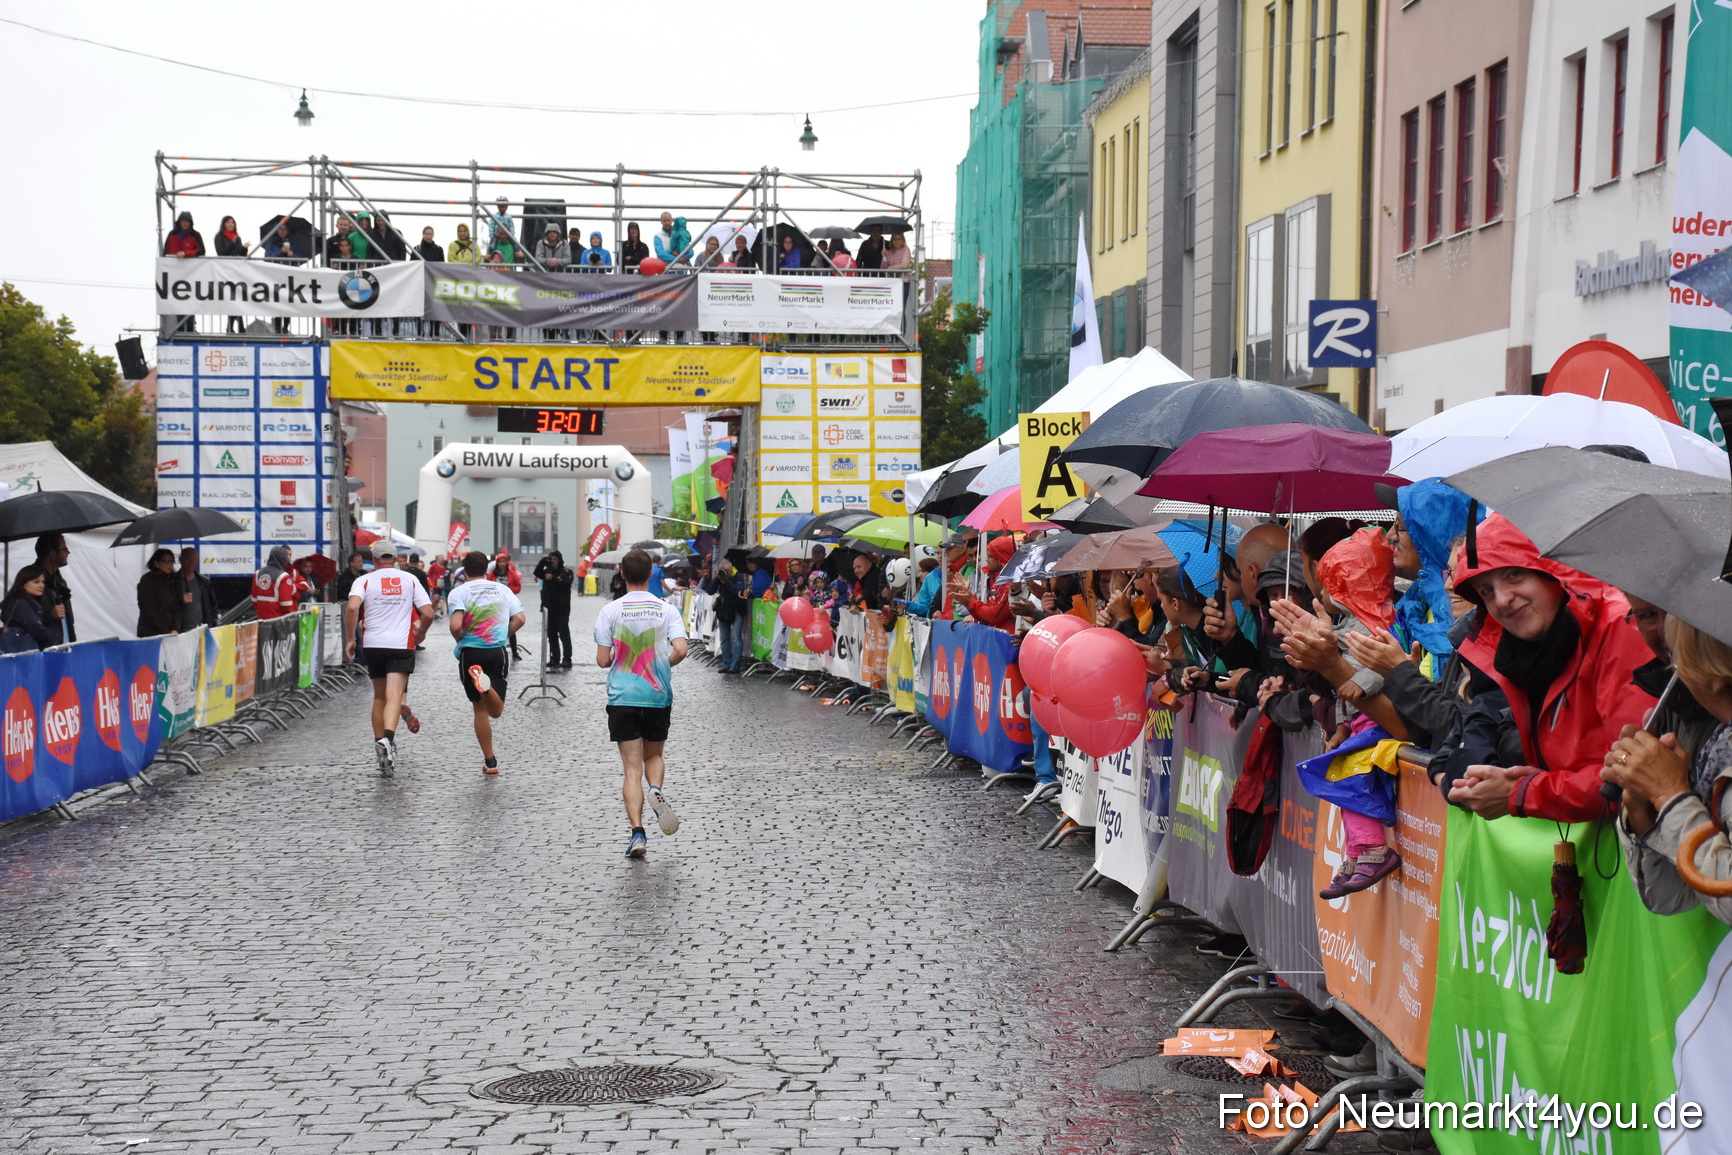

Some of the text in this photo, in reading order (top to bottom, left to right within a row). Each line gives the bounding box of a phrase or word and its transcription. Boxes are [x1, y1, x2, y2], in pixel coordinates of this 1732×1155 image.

[436, 281, 517, 302] BOCK
[536, 290, 575, 300] OFFICE
[707, 294, 755, 302] NeuerMarkt
[778, 295, 825, 304] NeuerMarkt
[847, 297, 894, 305] NeuerMarkt
[558, 304, 663, 314] www.bockonline.de
[355, 372, 448, 382] Neumarkter Stadtlauf
[474, 356, 620, 391] START
[646, 376, 736, 385] Neumarkter Stadtlauf
[820, 398, 850, 407] swn
[537, 411, 596, 432] 32:01
[1027, 418, 1081, 437] Block
[463, 451, 608, 471] BMW Laufsport
[1036, 446, 1077, 498] A
[590, 528, 610, 556] REWE
[621, 610, 663, 618] NeuerMarkt
